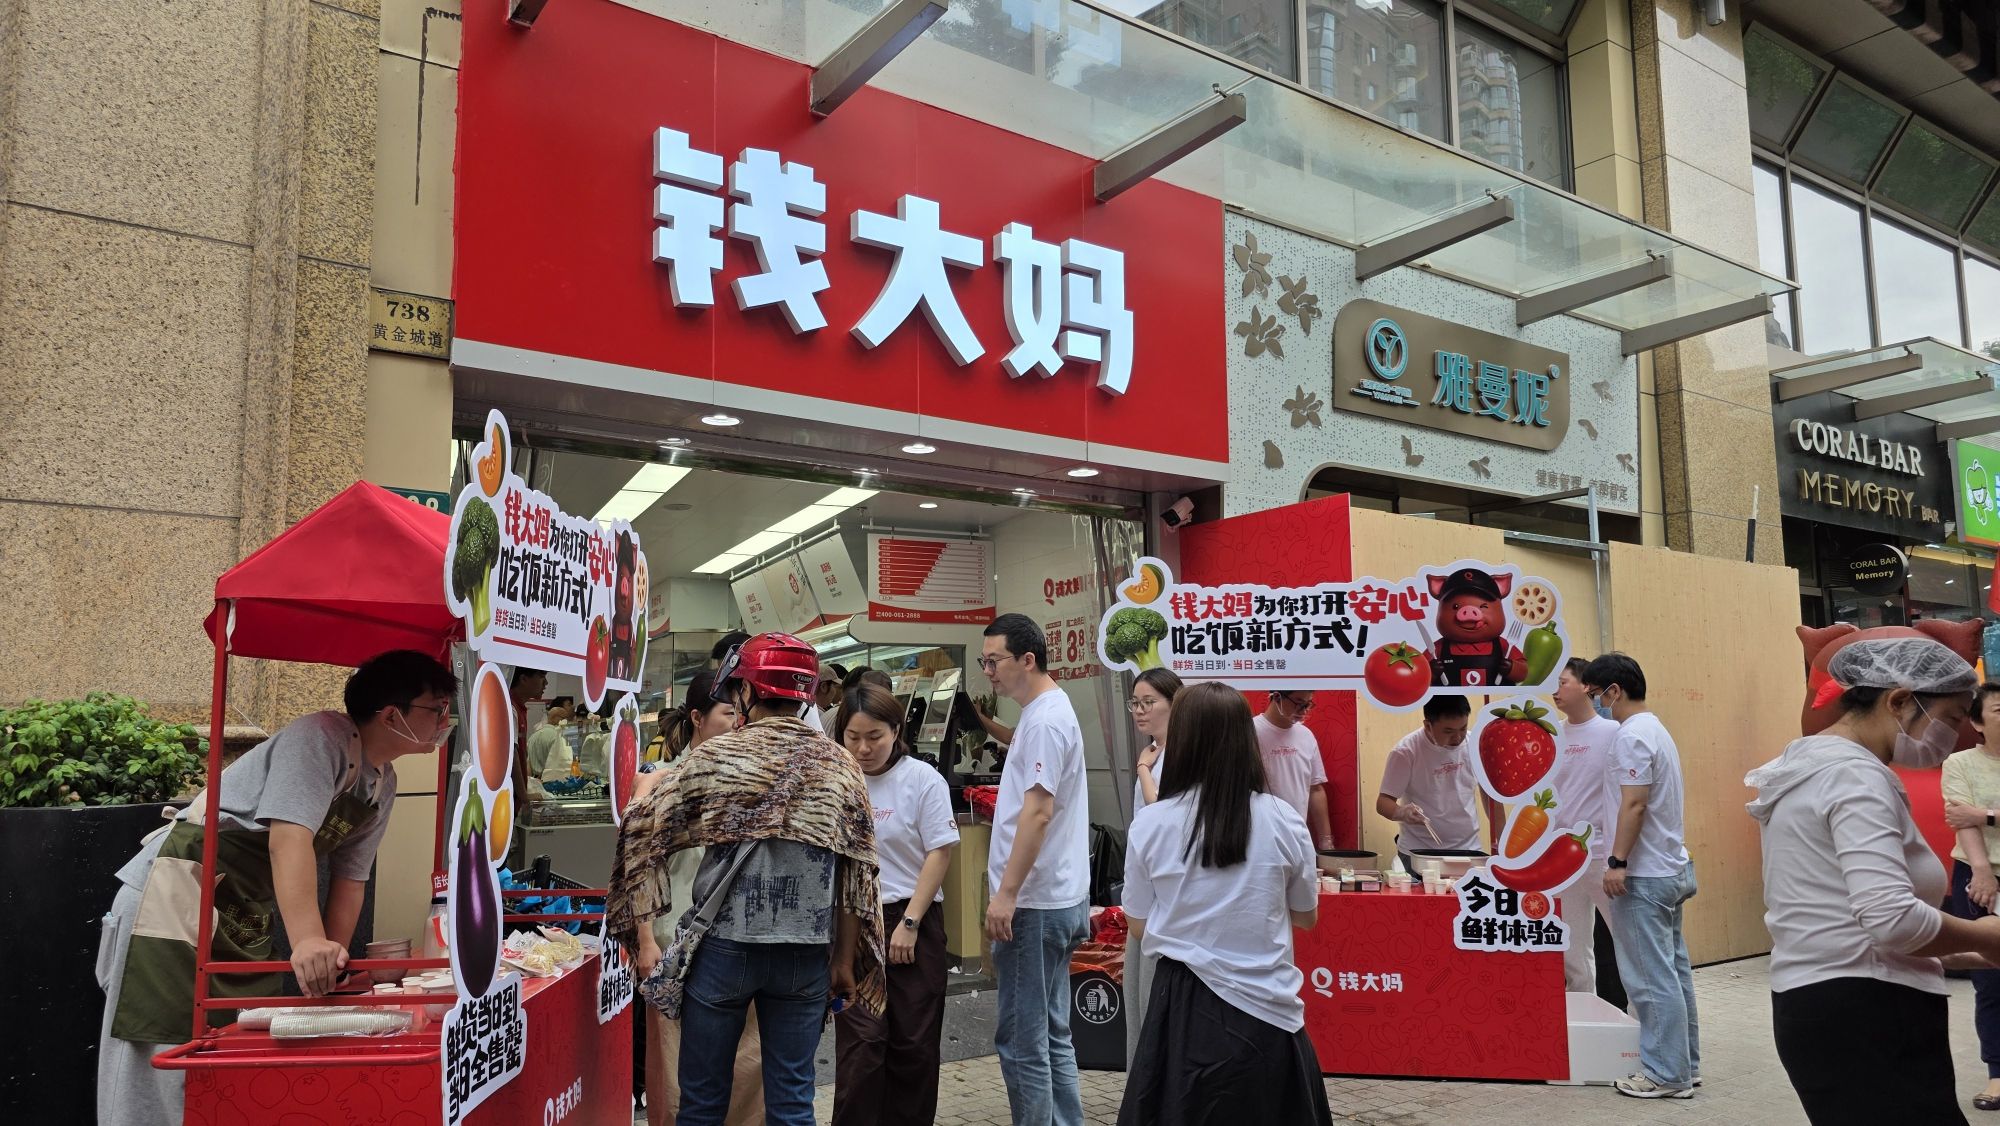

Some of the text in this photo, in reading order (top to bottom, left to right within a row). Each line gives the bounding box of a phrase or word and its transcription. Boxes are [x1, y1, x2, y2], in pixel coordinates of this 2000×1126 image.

[652, 126, 1135, 394] 钱大妈
[386, 300, 430, 322] 738
[372, 322, 444, 349] 黄金城道
[1430, 349, 1551, 427] 雅曼妮
[1790, 418, 1925, 477] CORAL BAR
[1797, 467, 1940, 524] MEMORY BAR
[504, 486, 615, 587] 钱大妈为你打开安心
[1850, 556, 1897, 570] CORAL BAR
[1855, 569, 1895, 580] Memory
[1169, 584, 1430, 624] 钱大妈为你打开安心
[1461, 875, 1519, 917] 今日
[603, 937, 620, 971] 今日
[1461, 916, 1564, 947] 鲜体验
[600, 965, 633, 1015] 鲜体验
[1338, 971, 1403, 993] 钱大妈
[446, 981, 518, 1082] 鲜货当日到
[448, 1020, 523, 1126] 当日全售罄
[555, 1077, 582, 1126] 钱大妈
